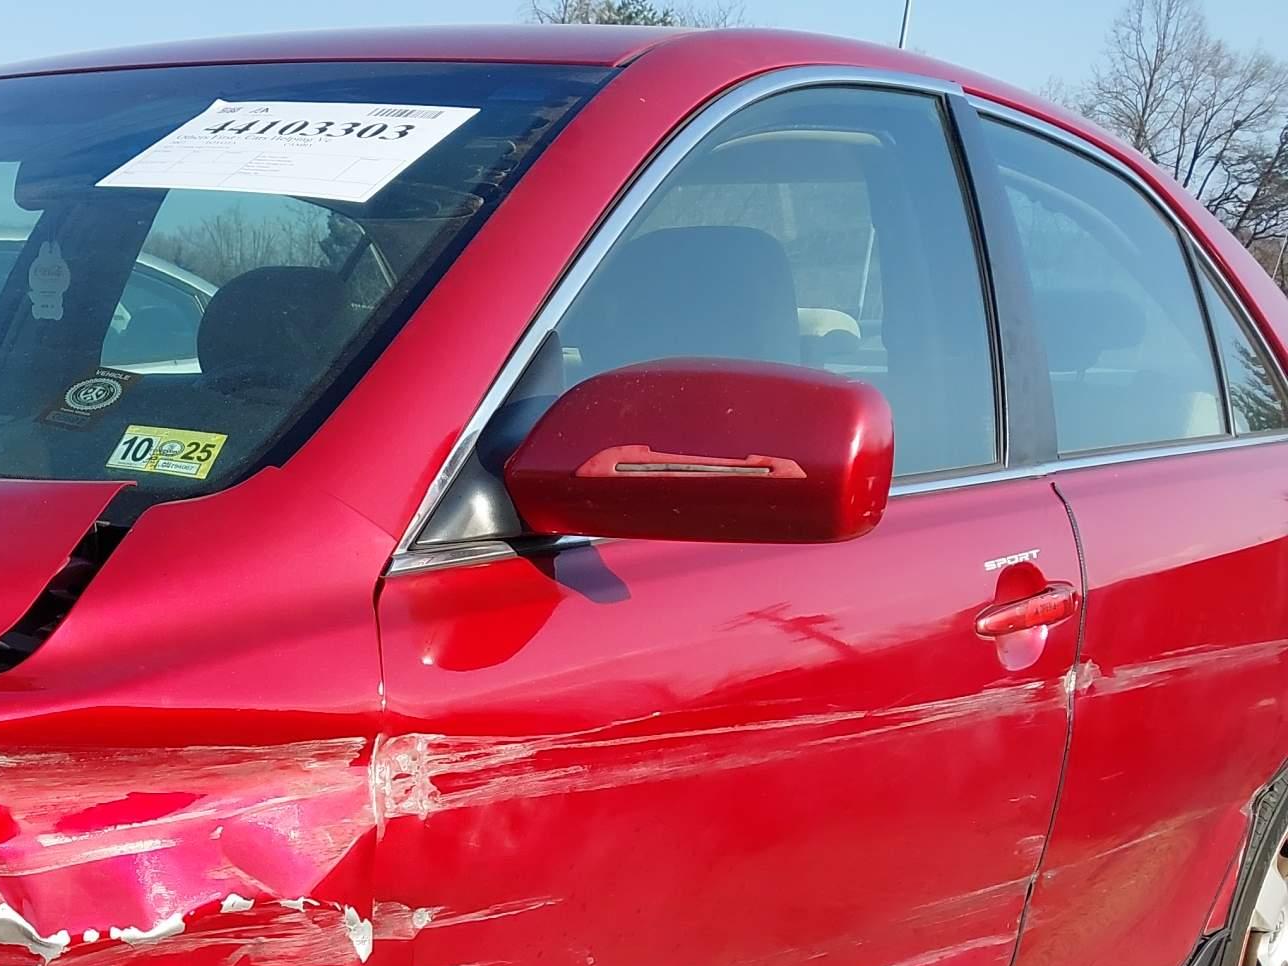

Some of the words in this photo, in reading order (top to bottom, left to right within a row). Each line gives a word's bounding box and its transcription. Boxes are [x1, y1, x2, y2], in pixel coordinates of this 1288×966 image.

[204, 119, 415, 140] 44103303
[95, 369, 131, 381] VEHICLE
[121, 436, 153, 462] 10
[181, 441, 216, 462] 25
[983, 549, 1041, 571] SPORT
